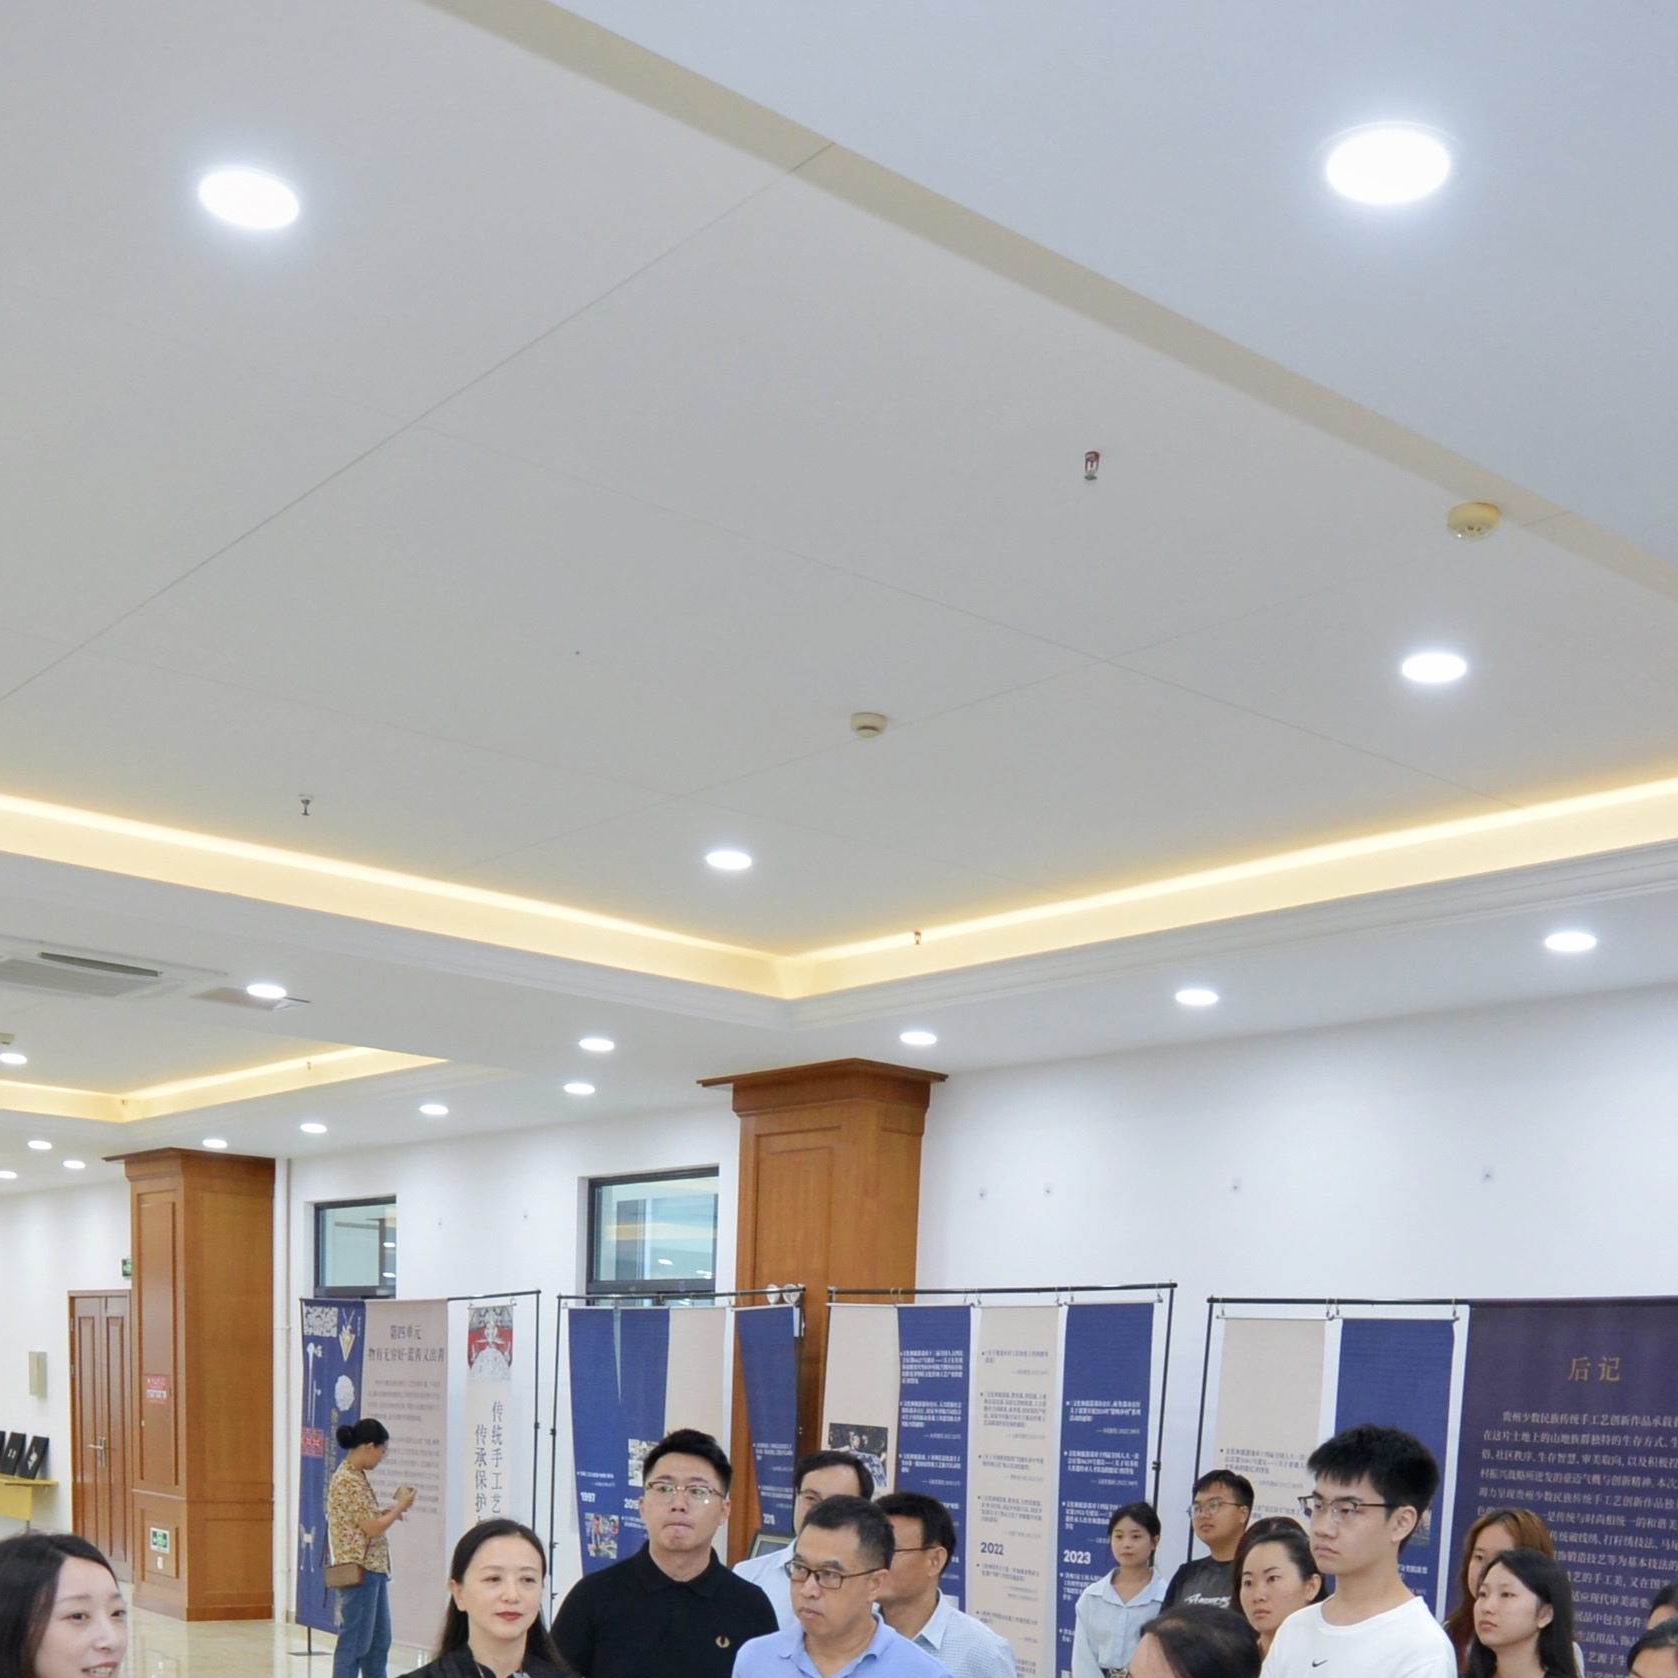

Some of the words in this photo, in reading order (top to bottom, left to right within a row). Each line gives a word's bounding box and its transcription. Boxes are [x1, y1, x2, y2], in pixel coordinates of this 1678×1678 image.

[1568, 1356, 1621, 1382] 后记
[491, 1401, 503, 1513] 传统手工艺
[474, 1423, 487, 1521] 传承保护
[980, 1541, 1004, 1556] 2022
[1063, 1550, 1092, 1565] 2023
